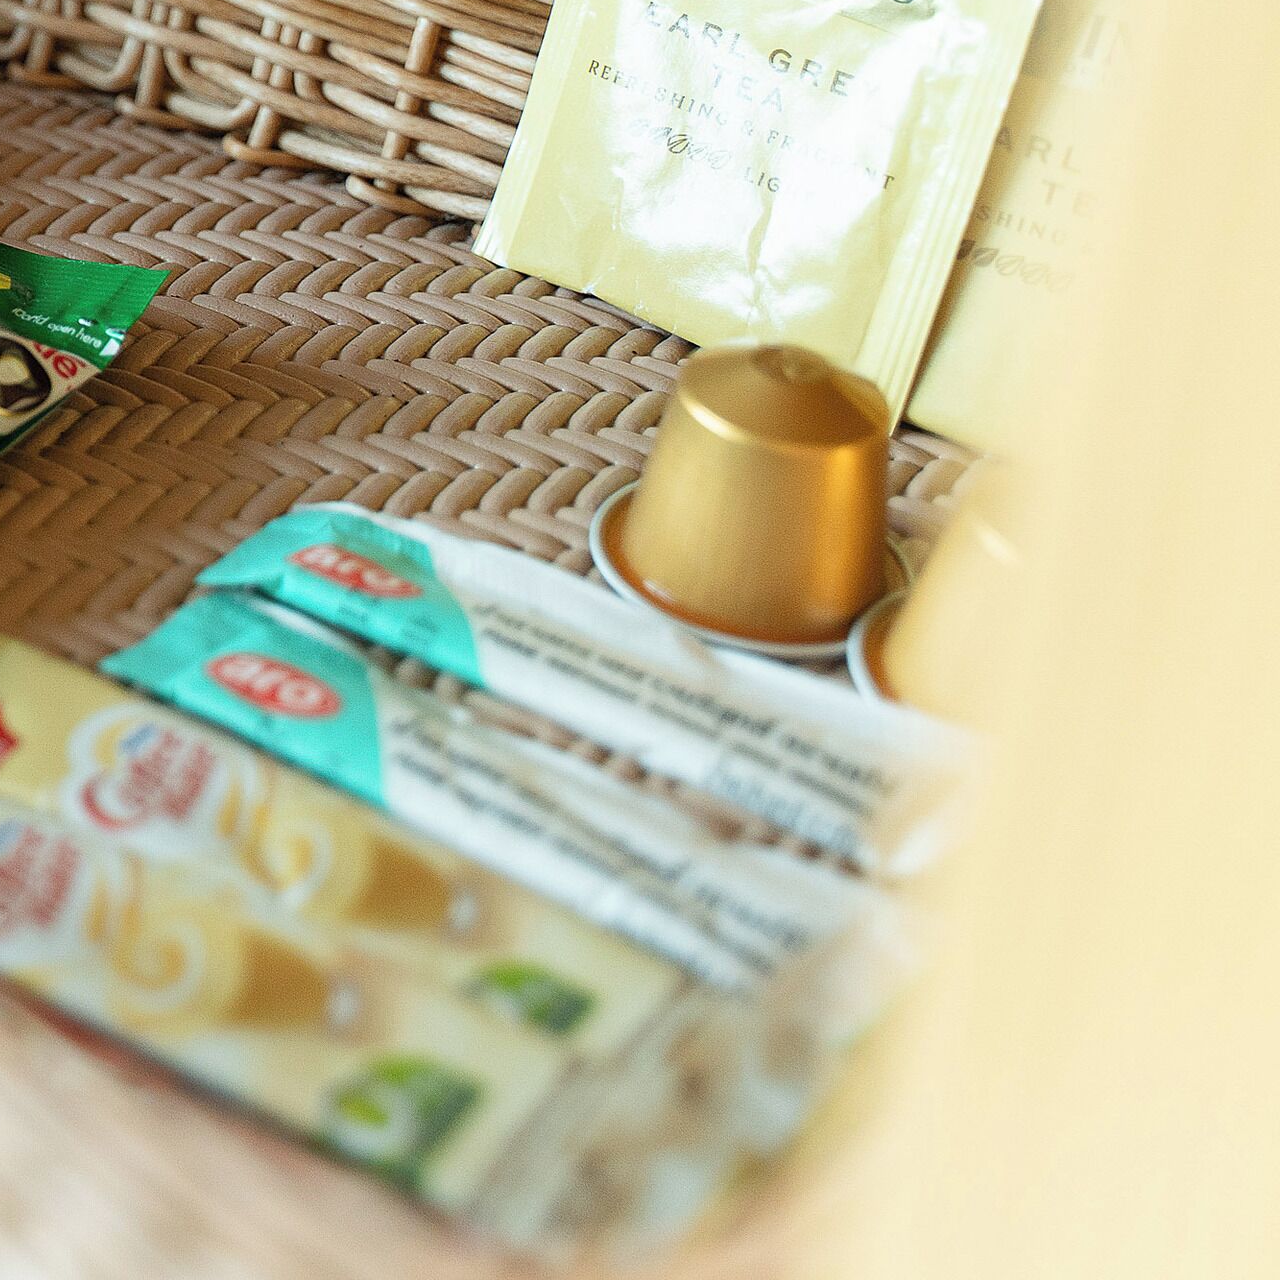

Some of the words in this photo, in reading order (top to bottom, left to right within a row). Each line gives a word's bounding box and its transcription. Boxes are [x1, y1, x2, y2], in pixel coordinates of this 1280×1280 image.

[645, 1, 746, 58] EARL
[712, 62, 784, 113] TEA
[47, 323, 75, 339] open
[76, 326, 102, 349] here
[219, 657, 322, 711] aro
